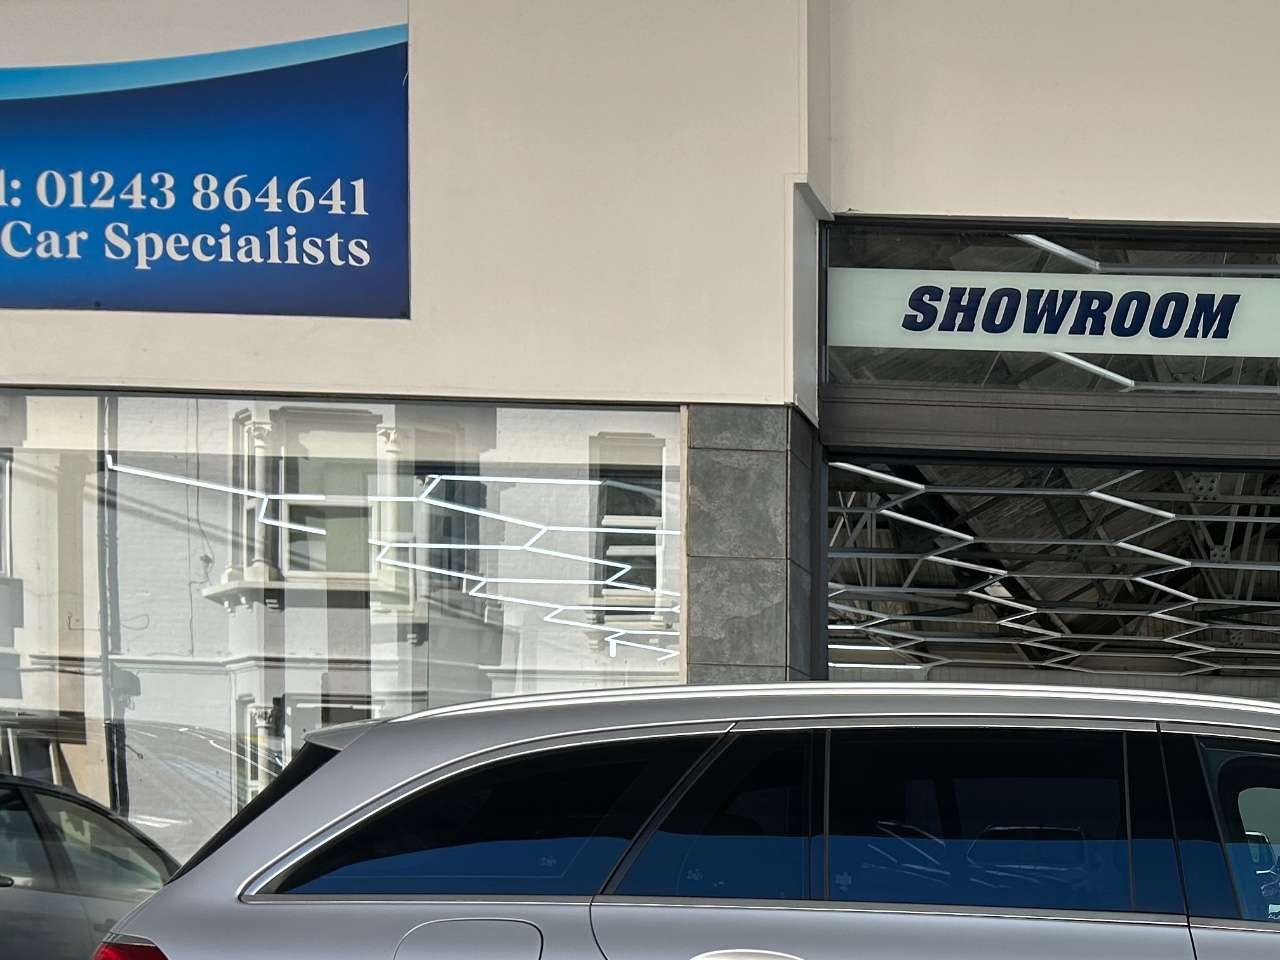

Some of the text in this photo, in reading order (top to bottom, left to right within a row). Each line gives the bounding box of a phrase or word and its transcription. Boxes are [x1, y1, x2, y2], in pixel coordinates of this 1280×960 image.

[36, 170, 175, 209] 01243
[192, 174, 369, 216] 864641
[0, 220, 371, 270] Car Specialists
[901, 285, 1241, 339] SHOWROOM
